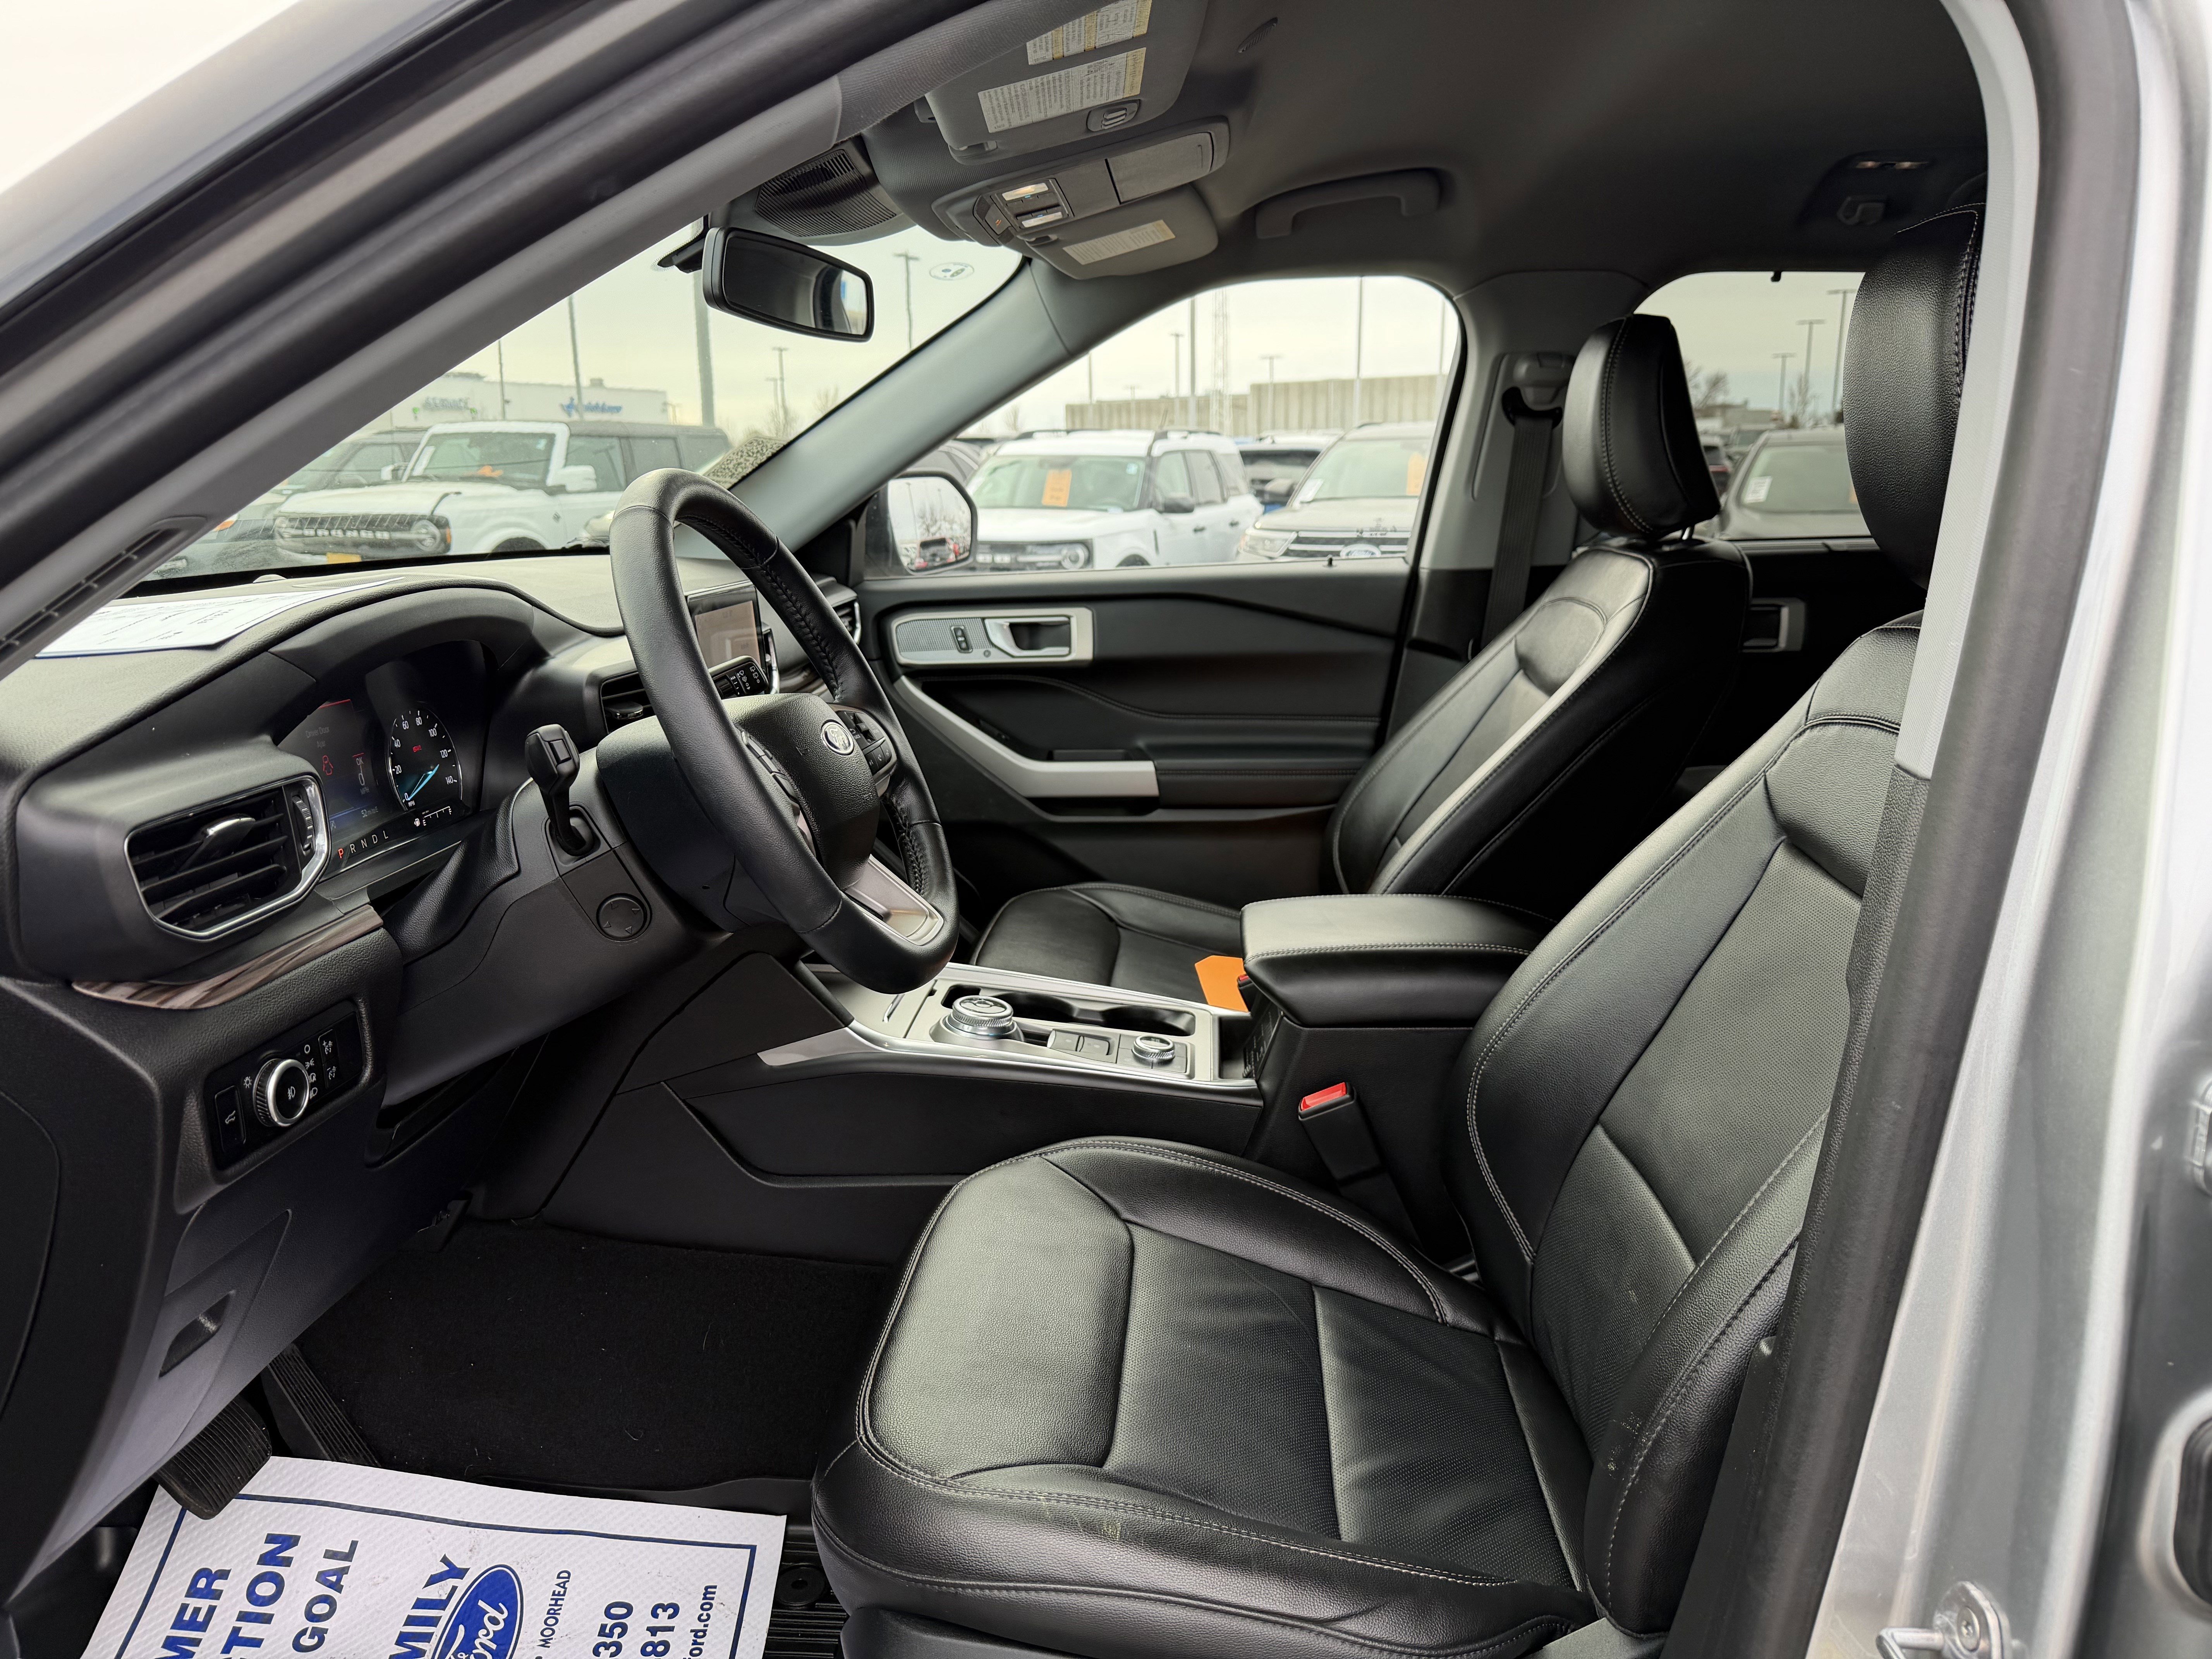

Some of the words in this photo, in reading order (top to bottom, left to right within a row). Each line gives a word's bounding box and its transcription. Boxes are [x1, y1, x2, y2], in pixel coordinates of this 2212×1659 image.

[402, 721, 409, 730] 60
[416, 717, 422, 726] 80
[429, 728, 437, 737] 100
[394, 739, 400, 748] 40
[356, 757, 364, 765] OK
[395, 765, 402, 774] 20
[338, 848, 344, 859] P
[350, 843, 356, 854] R
[361, 838, 368, 848] N
[372, 834, 378, 844] D
[383, 830, 388, 839] L
[220, 1533, 301, 1659] TION
[292, 1540, 359, 1653] GOAL
[536, 1570, 571, 1648] MOORHEAD
[592, 1601, 634, 1658] 350
[640, 1602, 680, 1658] 813
[683, 1585, 718, 1659] ord.com
